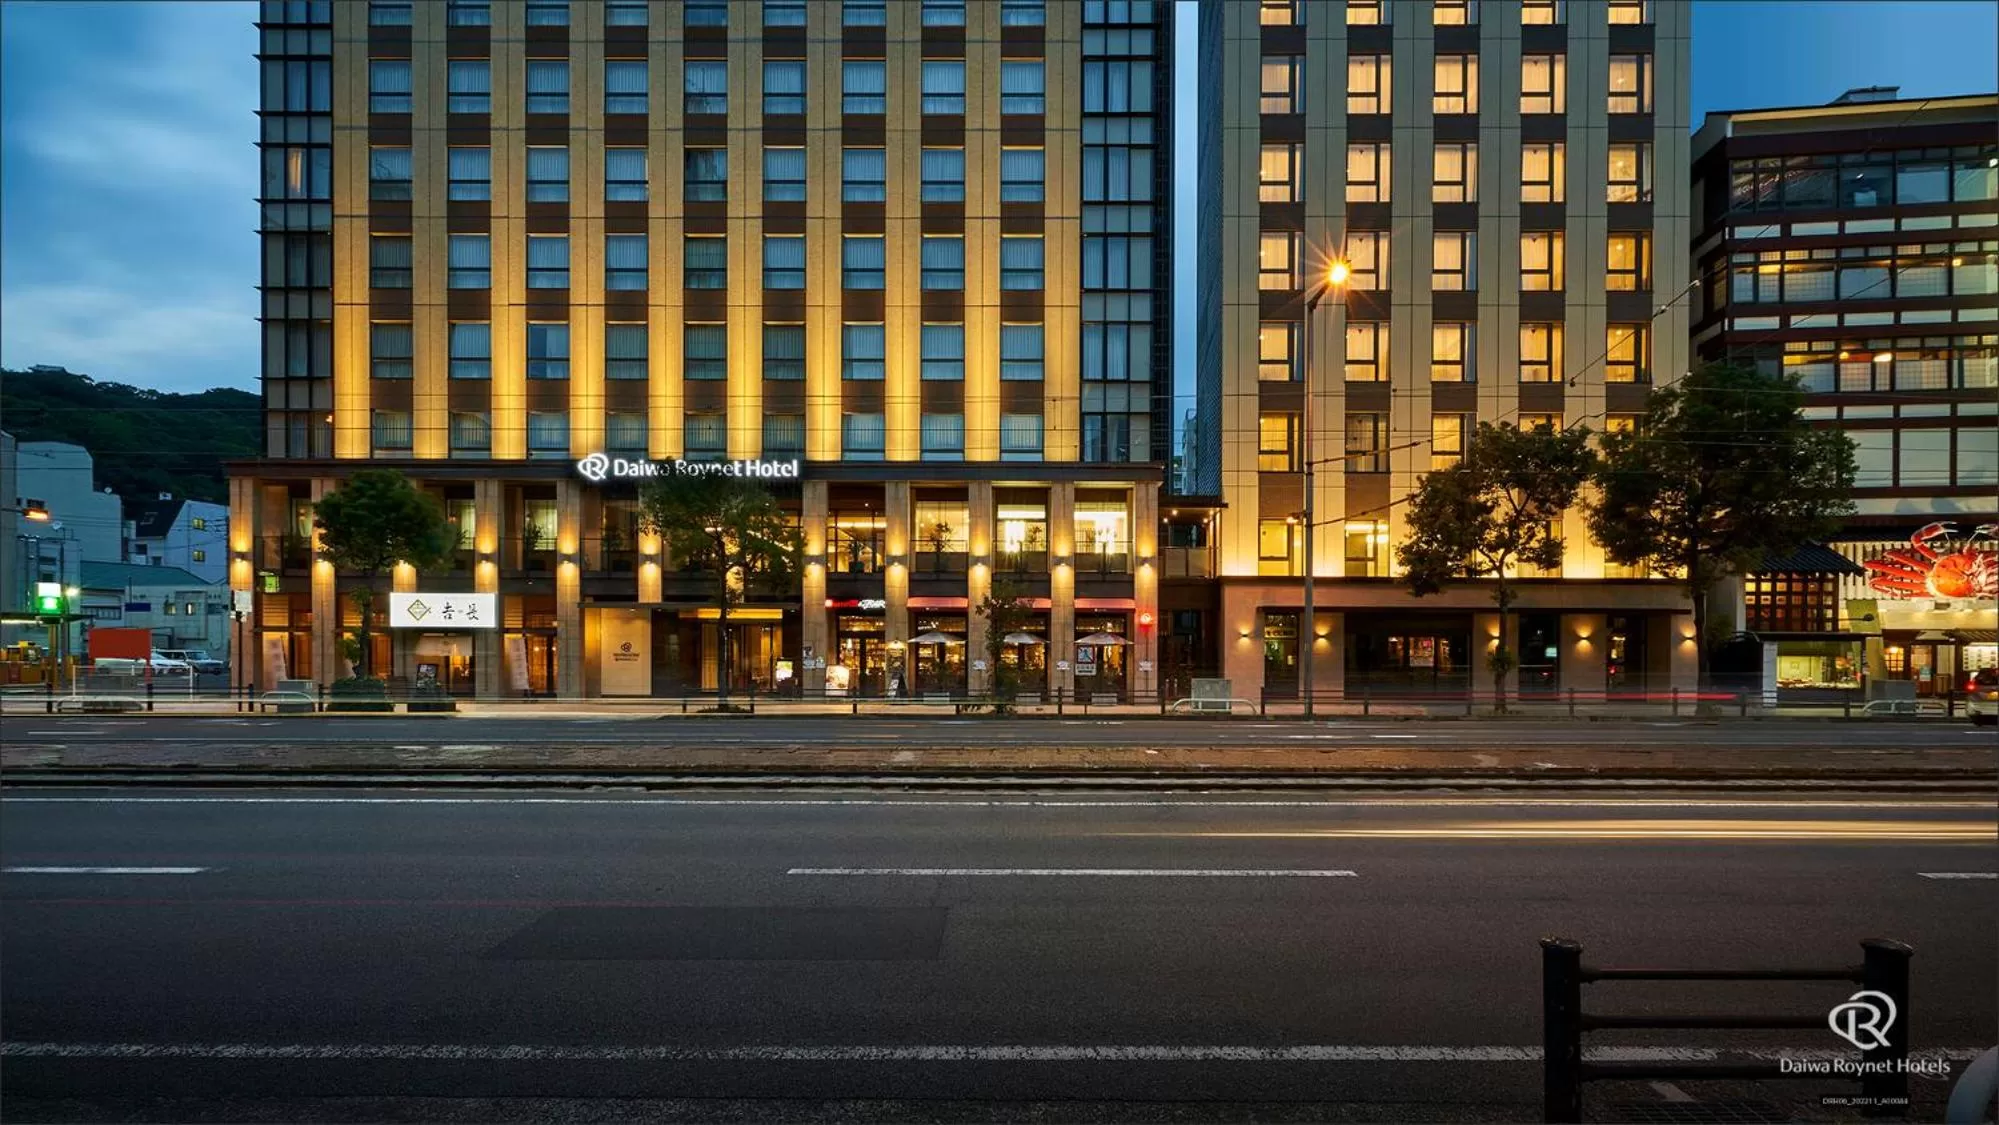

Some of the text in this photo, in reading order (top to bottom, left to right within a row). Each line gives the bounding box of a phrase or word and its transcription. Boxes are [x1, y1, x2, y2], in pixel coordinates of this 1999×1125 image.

[613, 459, 798, 479] Daiwa Roynet Hotel
